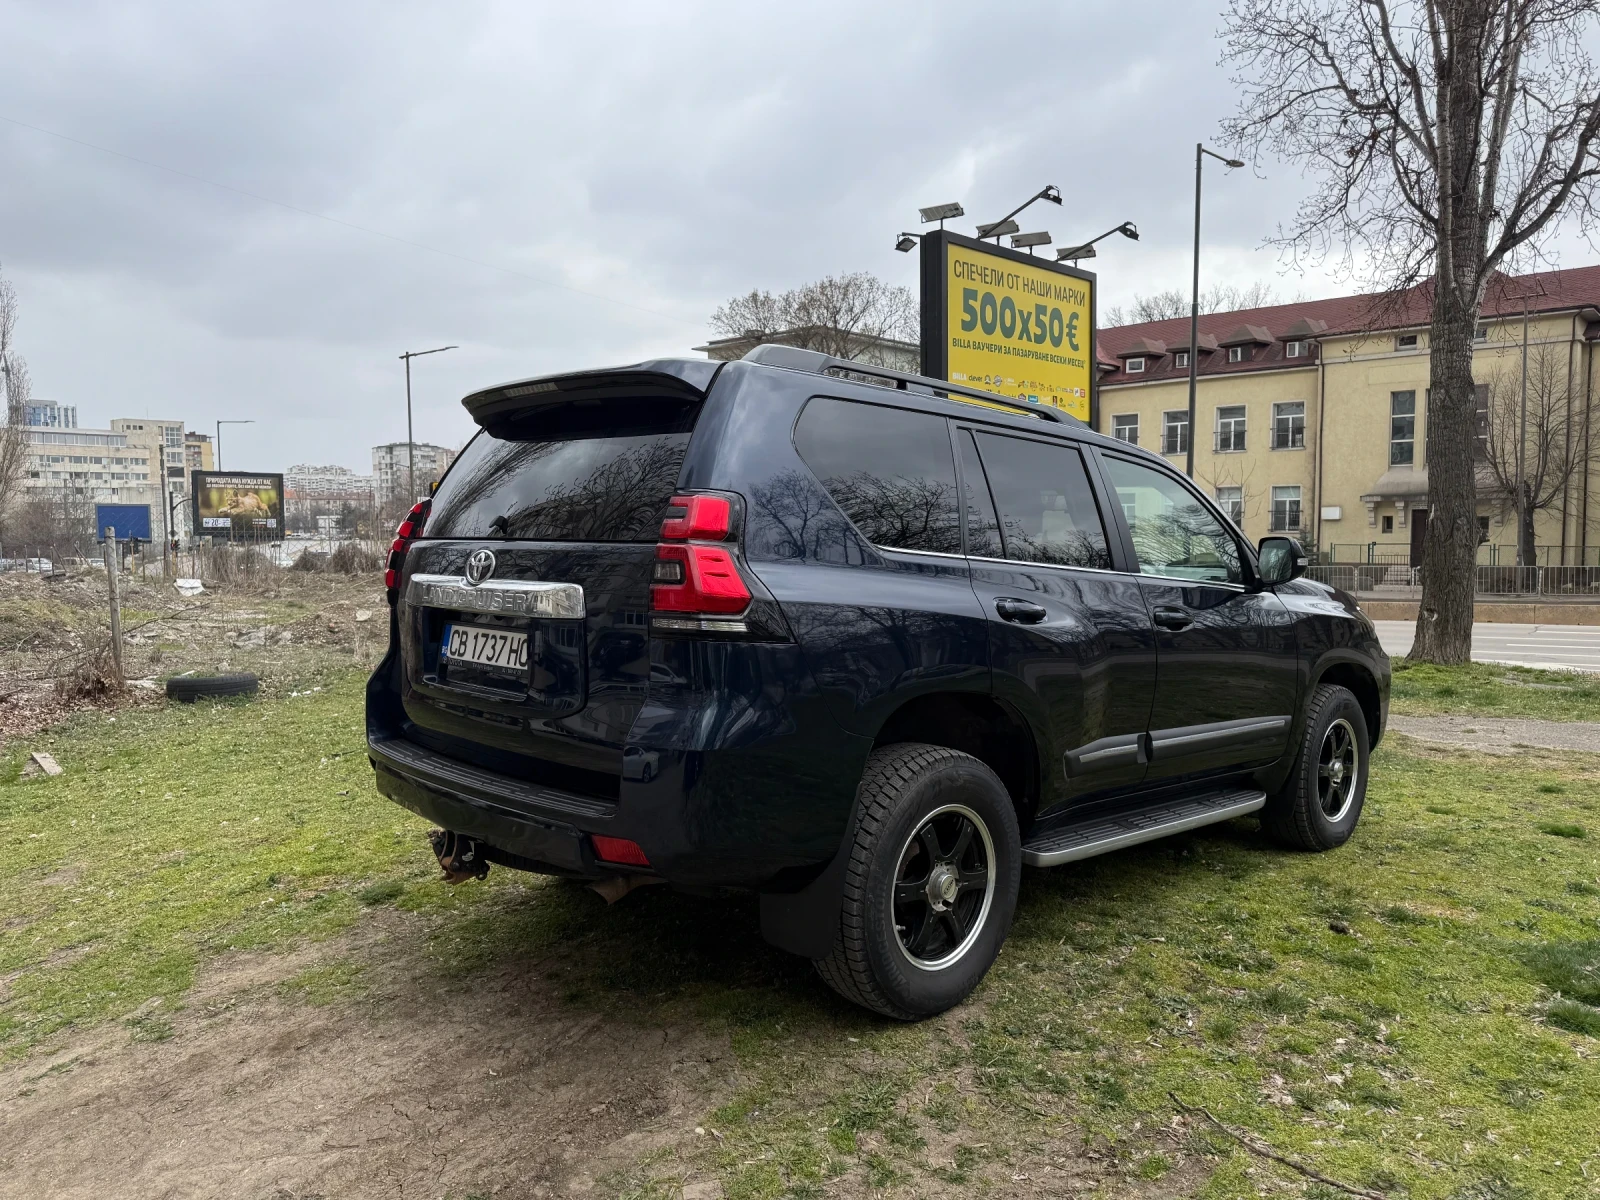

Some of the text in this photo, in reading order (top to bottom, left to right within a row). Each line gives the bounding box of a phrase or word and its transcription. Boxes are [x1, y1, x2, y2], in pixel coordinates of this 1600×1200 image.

[954, 259, 1086, 308] СПЕЧЕЛИ ОТ НАШИ МАРКИ
[952, 337, 972, 350] BILLA
[972, 340, 1003, 355] ВАУЧЕРИ
[1003, 345, 1012, 356] ЗА
[1012, 347, 1050, 362] ПАЗАРУВАНЕ
[1050, 354, 1067, 365] ВСЕКИ
[457, 588, 528, 612] CRUISER
[449, 629, 469, 657] CB
[471, 632, 508, 663] 1737
